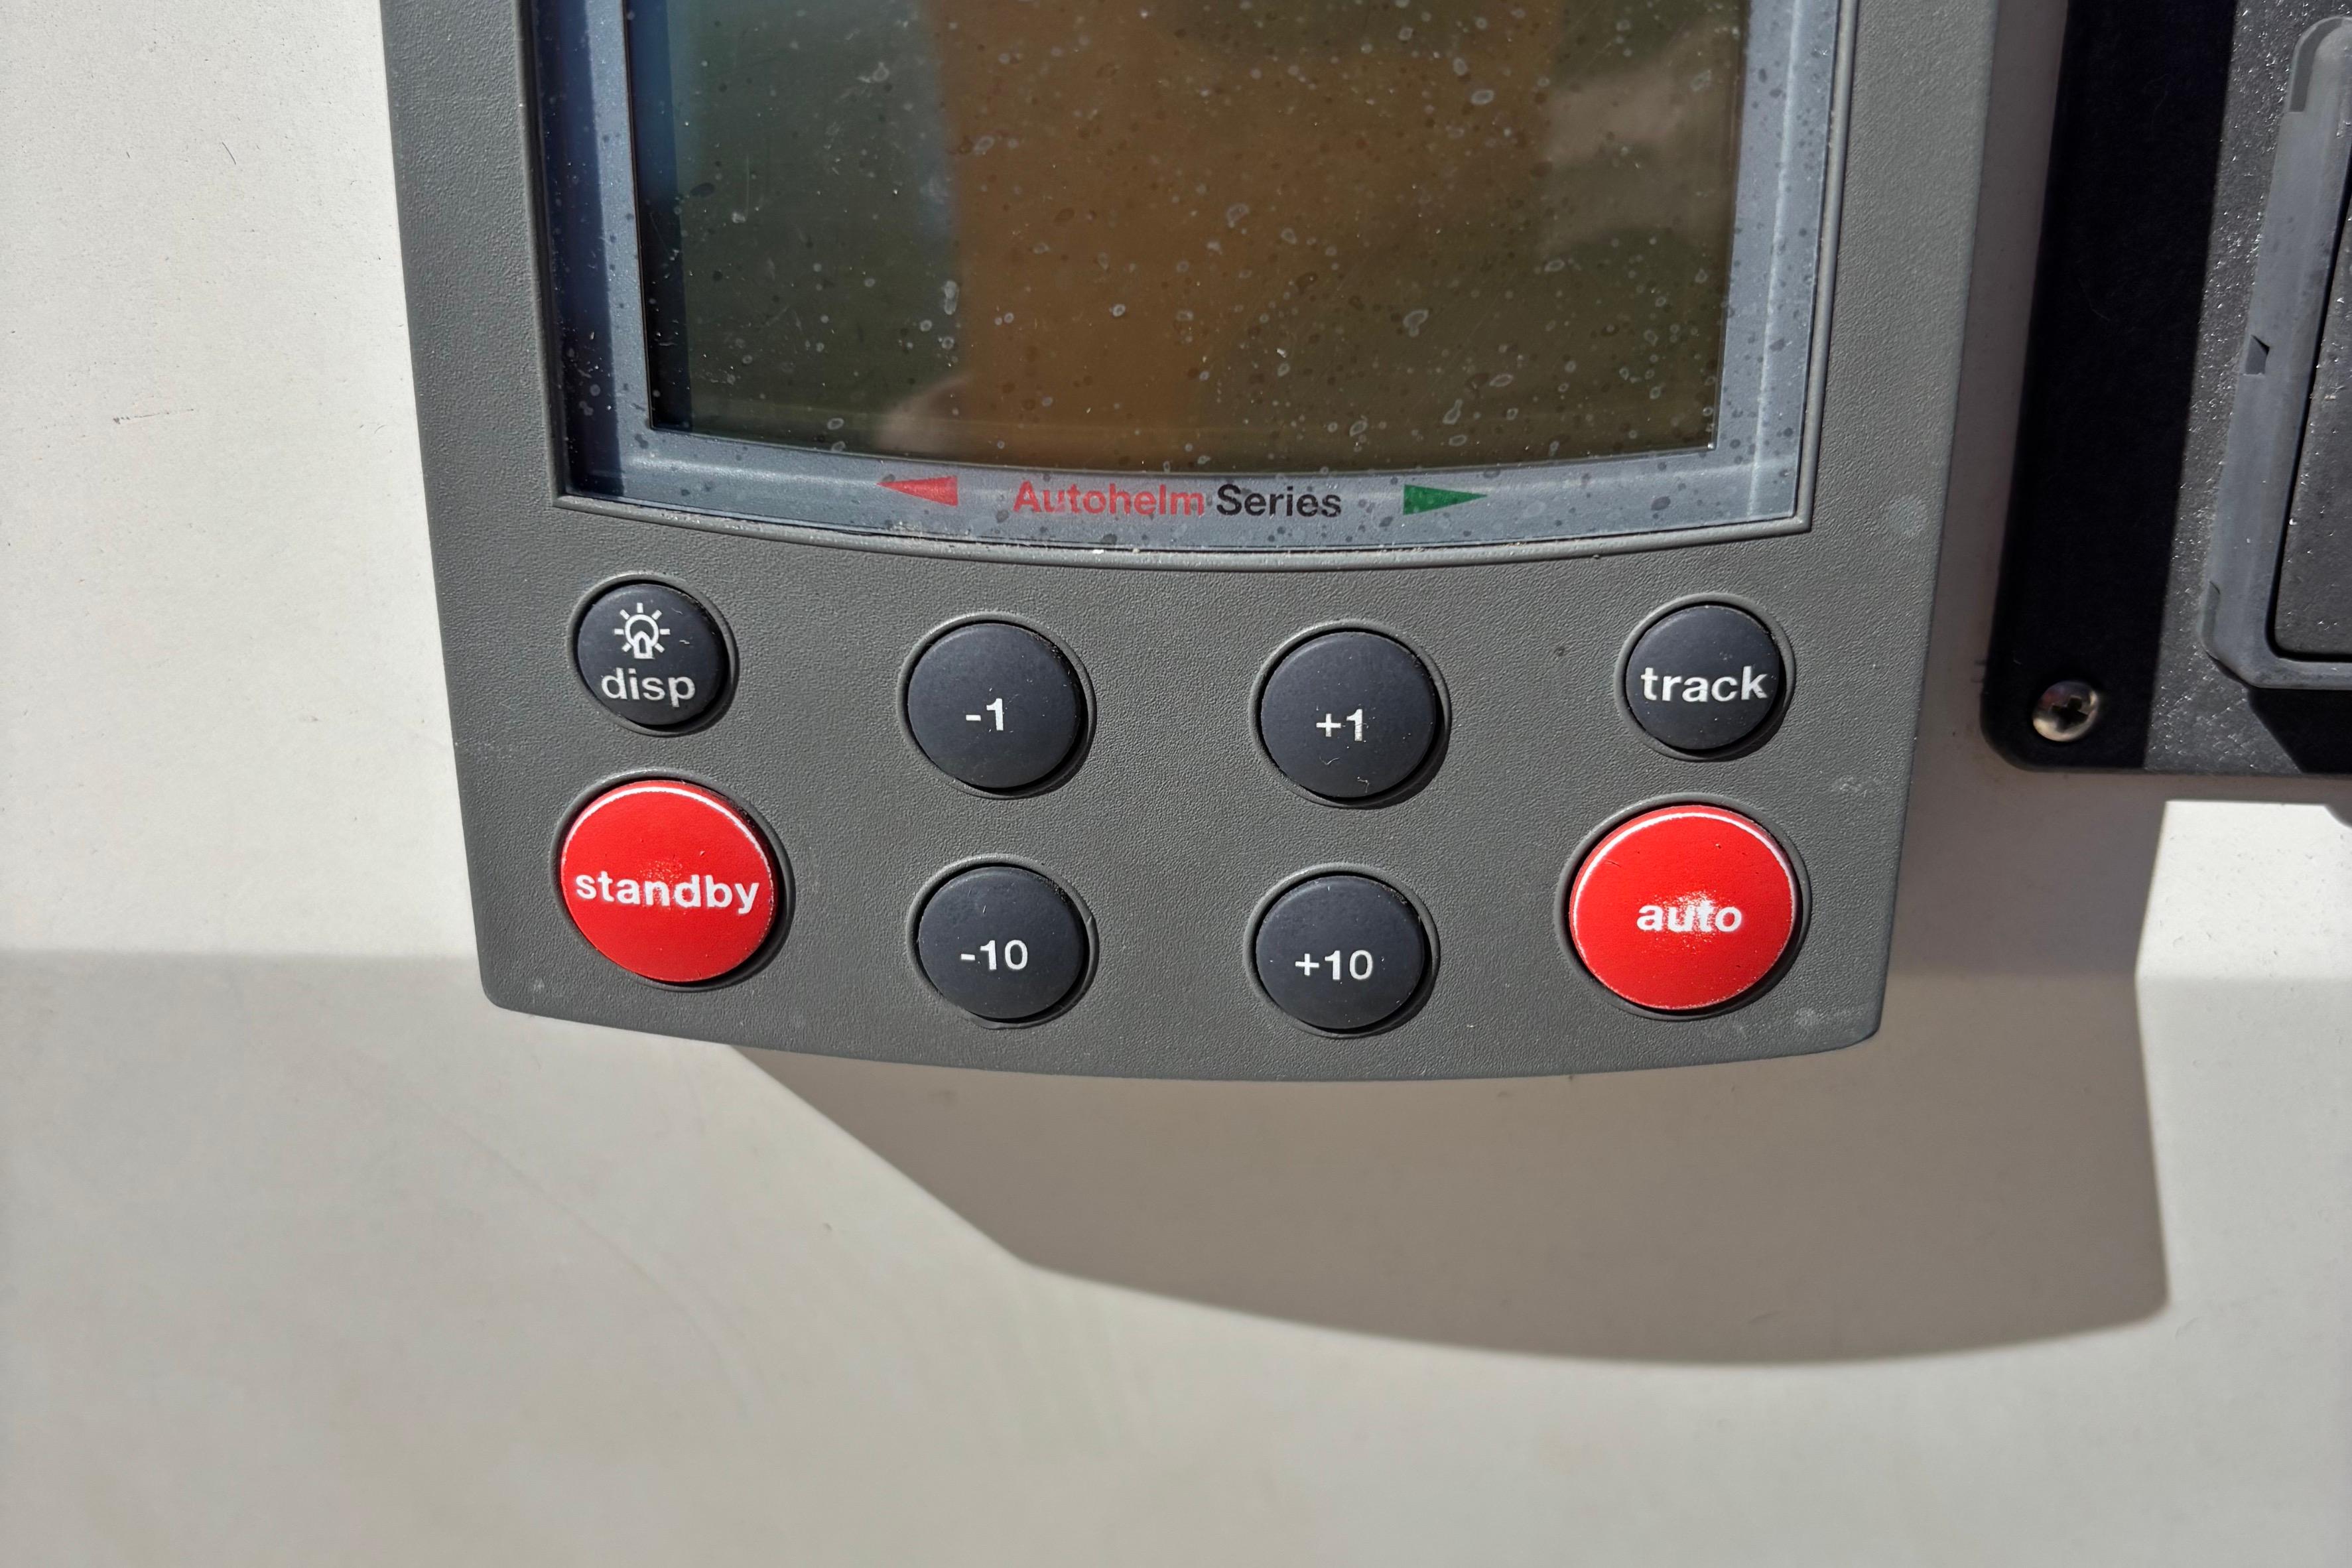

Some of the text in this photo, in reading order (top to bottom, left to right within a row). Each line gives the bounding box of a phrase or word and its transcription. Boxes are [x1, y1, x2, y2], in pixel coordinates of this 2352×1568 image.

[1013, 480, 1342, 518] Autohelm Series
[600, 667, 696, 708] disp
[1640, 665, 1768, 703] track
[964, 697, 1005, 732] -1
[1315, 708, 1364, 742] +1
[574, 870, 760, 915] standby
[1636, 898, 1744, 934] auto
[960, 939, 1029, 971] -10
[1294, 949, 1374, 981] +10
